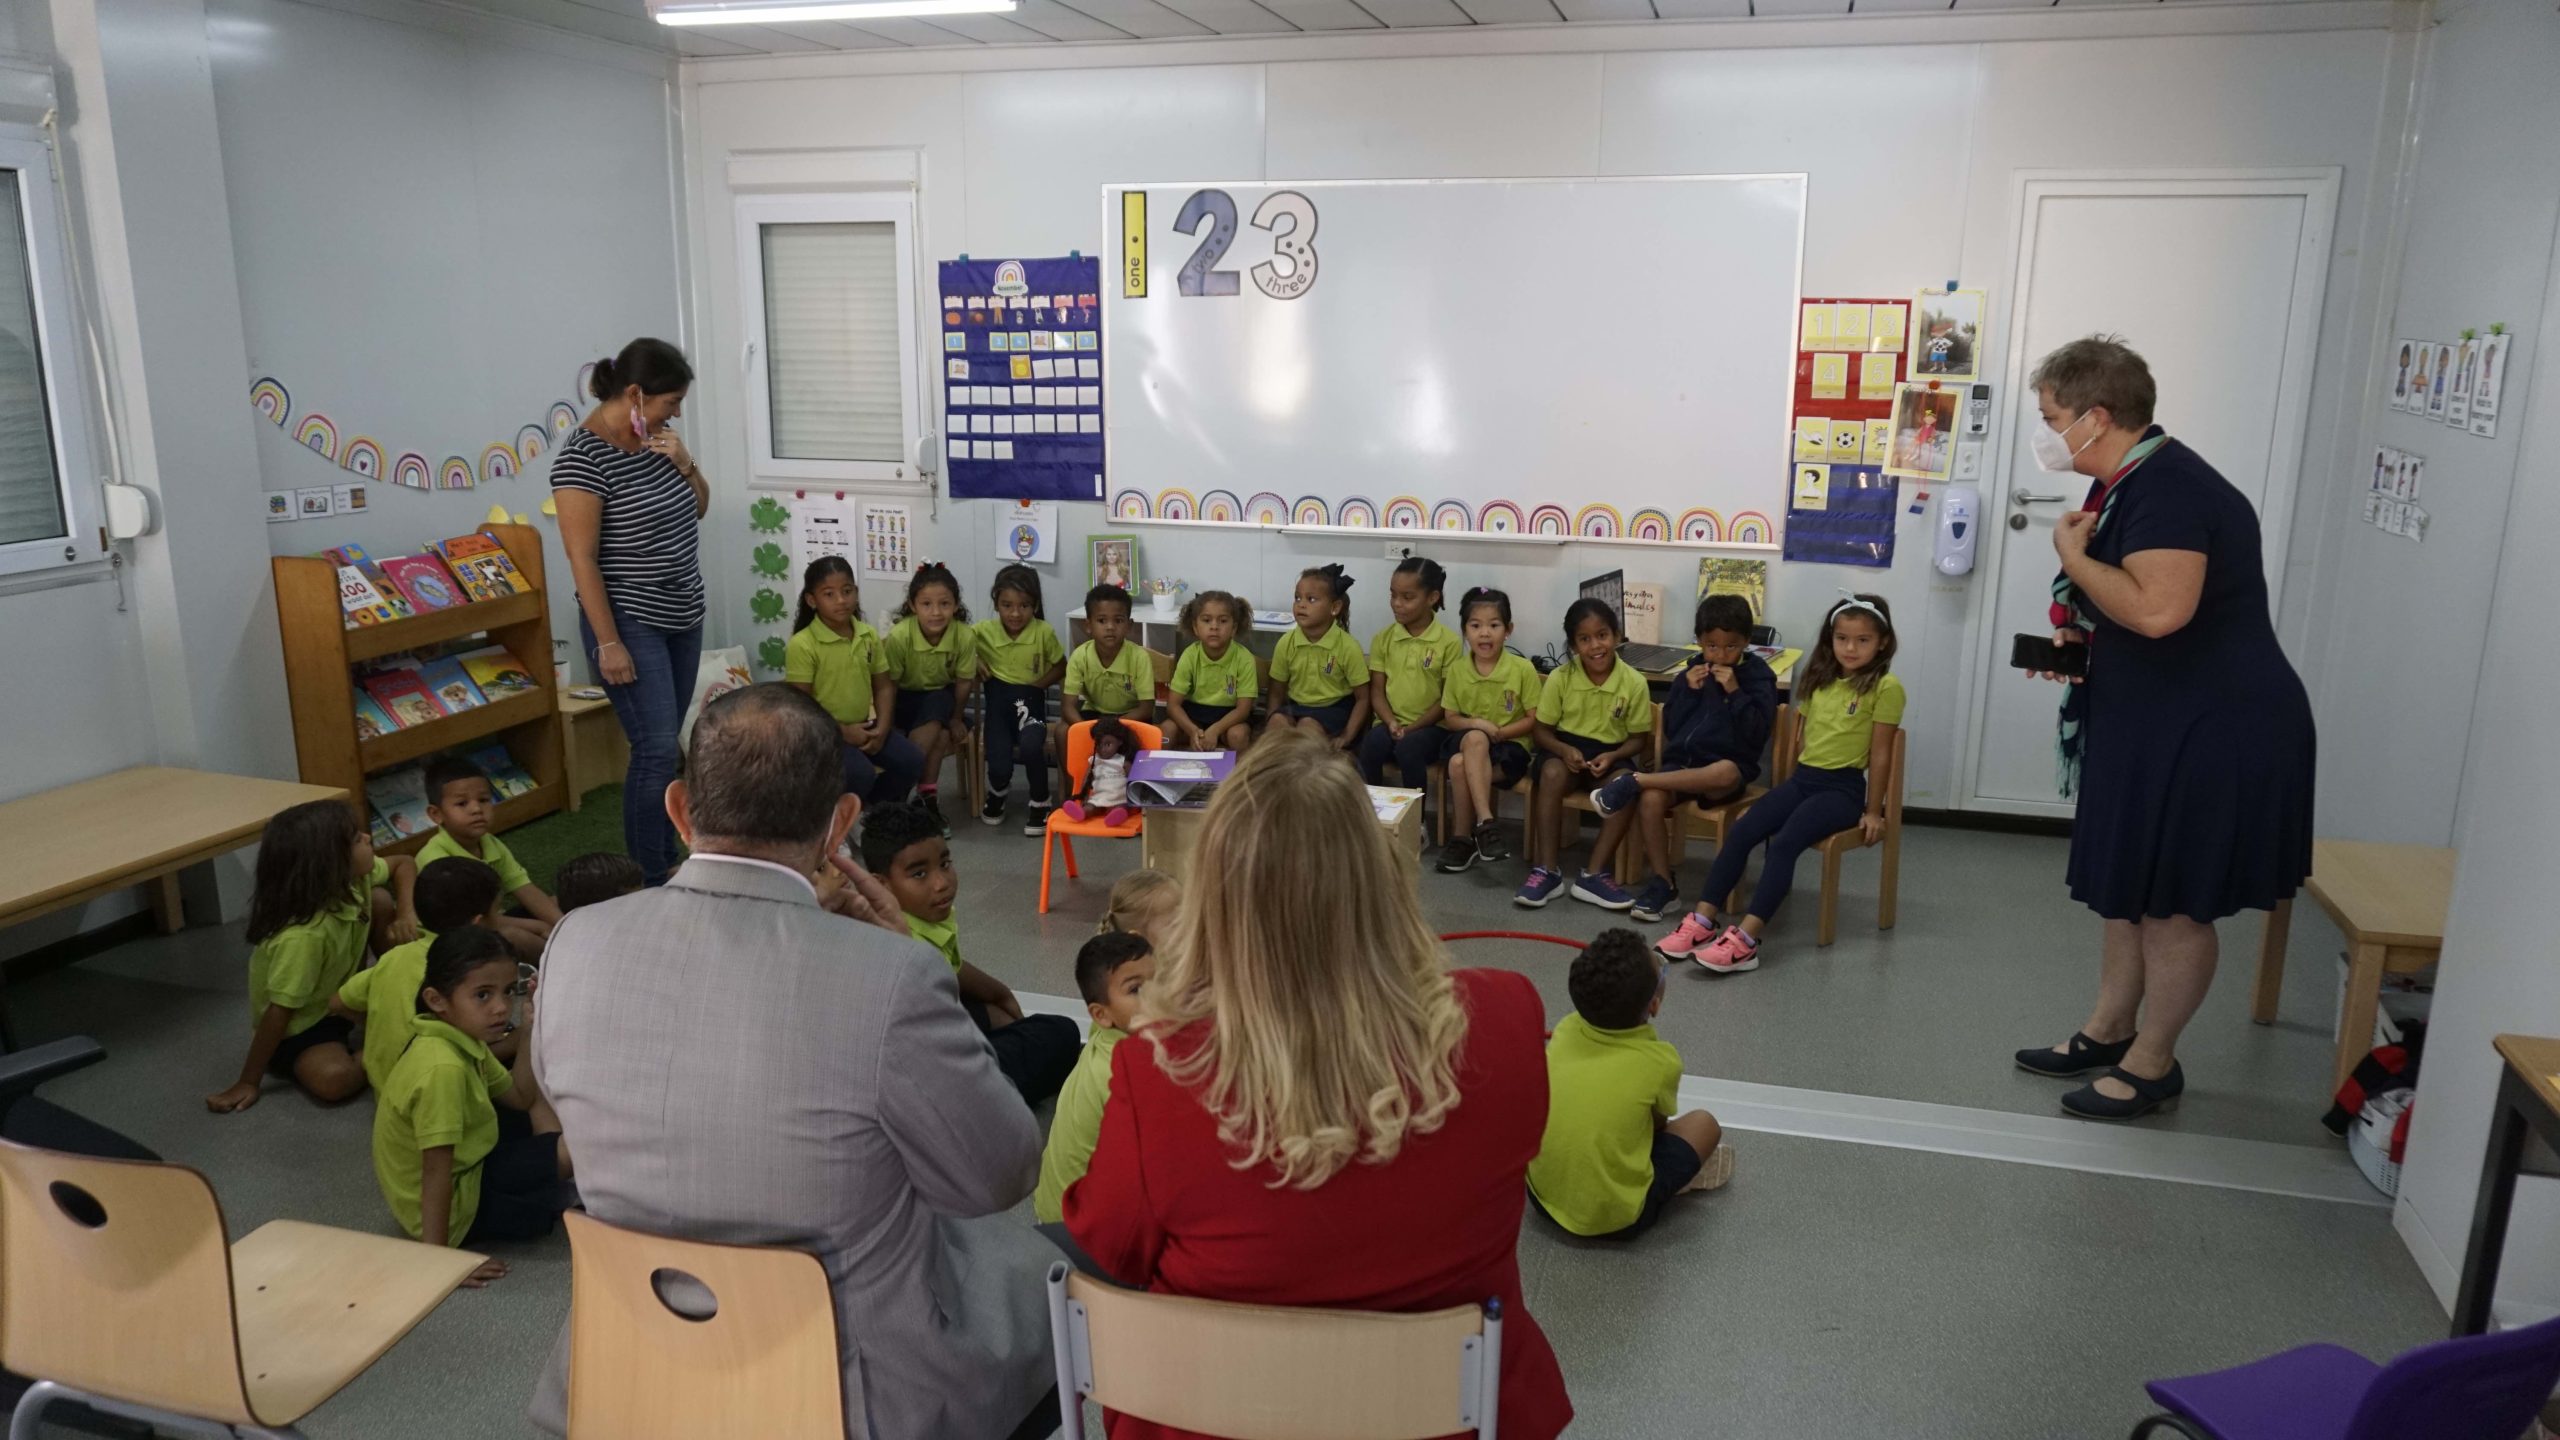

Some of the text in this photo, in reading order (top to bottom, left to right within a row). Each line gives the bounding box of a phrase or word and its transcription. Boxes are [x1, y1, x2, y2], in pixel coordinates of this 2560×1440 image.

[1172, 188, 1241, 297] 2
[1249, 190, 1319, 300] 3
[1130, 257, 1140, 288] one
[1192, 249, 1215, 274] two
[1266, 274, 1307, 294] three
[1815, 313, 1897, 337] 1 2 3
[1823, 362, 1886, 384] 4 5
[1624, 598, 1655, 612] imales
